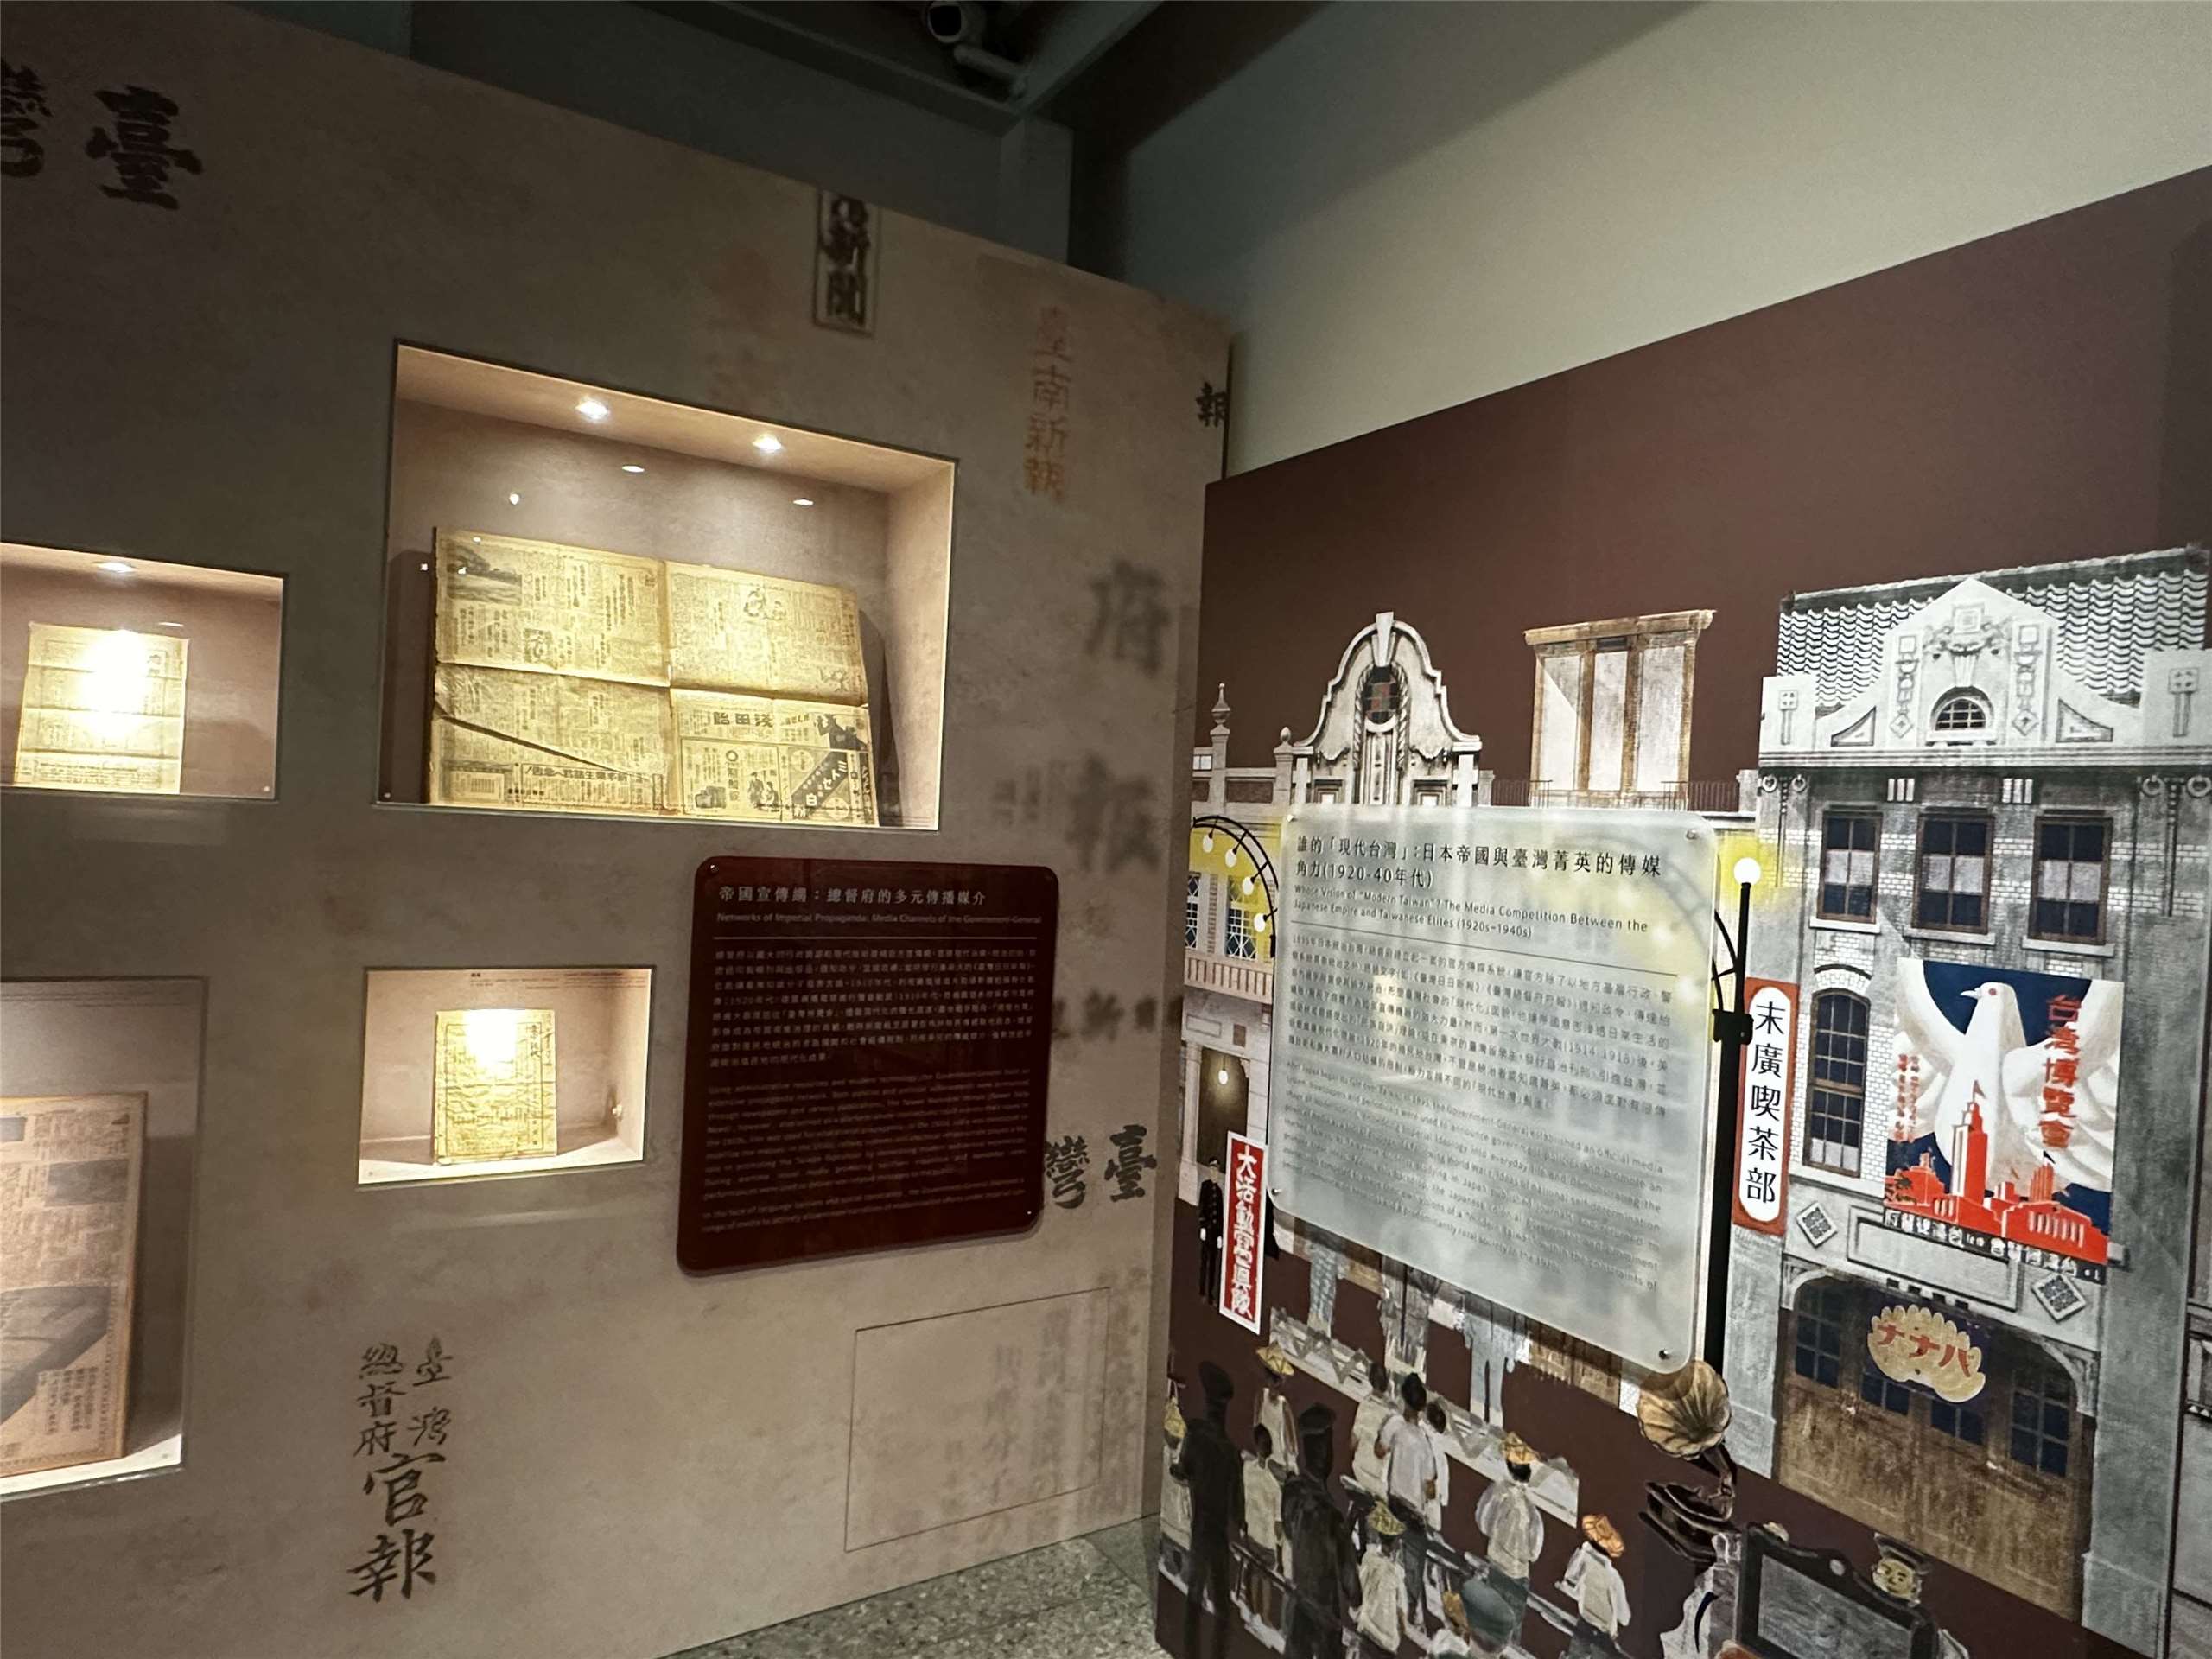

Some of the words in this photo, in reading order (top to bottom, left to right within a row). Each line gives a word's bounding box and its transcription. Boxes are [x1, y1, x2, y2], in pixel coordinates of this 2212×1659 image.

[1361, 906, 1376, 918] and
[1444, 899, 1461, 912] The
[1465, 901, 1495, 916] Media
[1499, 905, 1566, 925] Competition
[1570, 912, 1623, 930] Between
[1627, 918, 1648, 933] the
[1746, 1000, 1786, 1205] 末廣喫茶部
